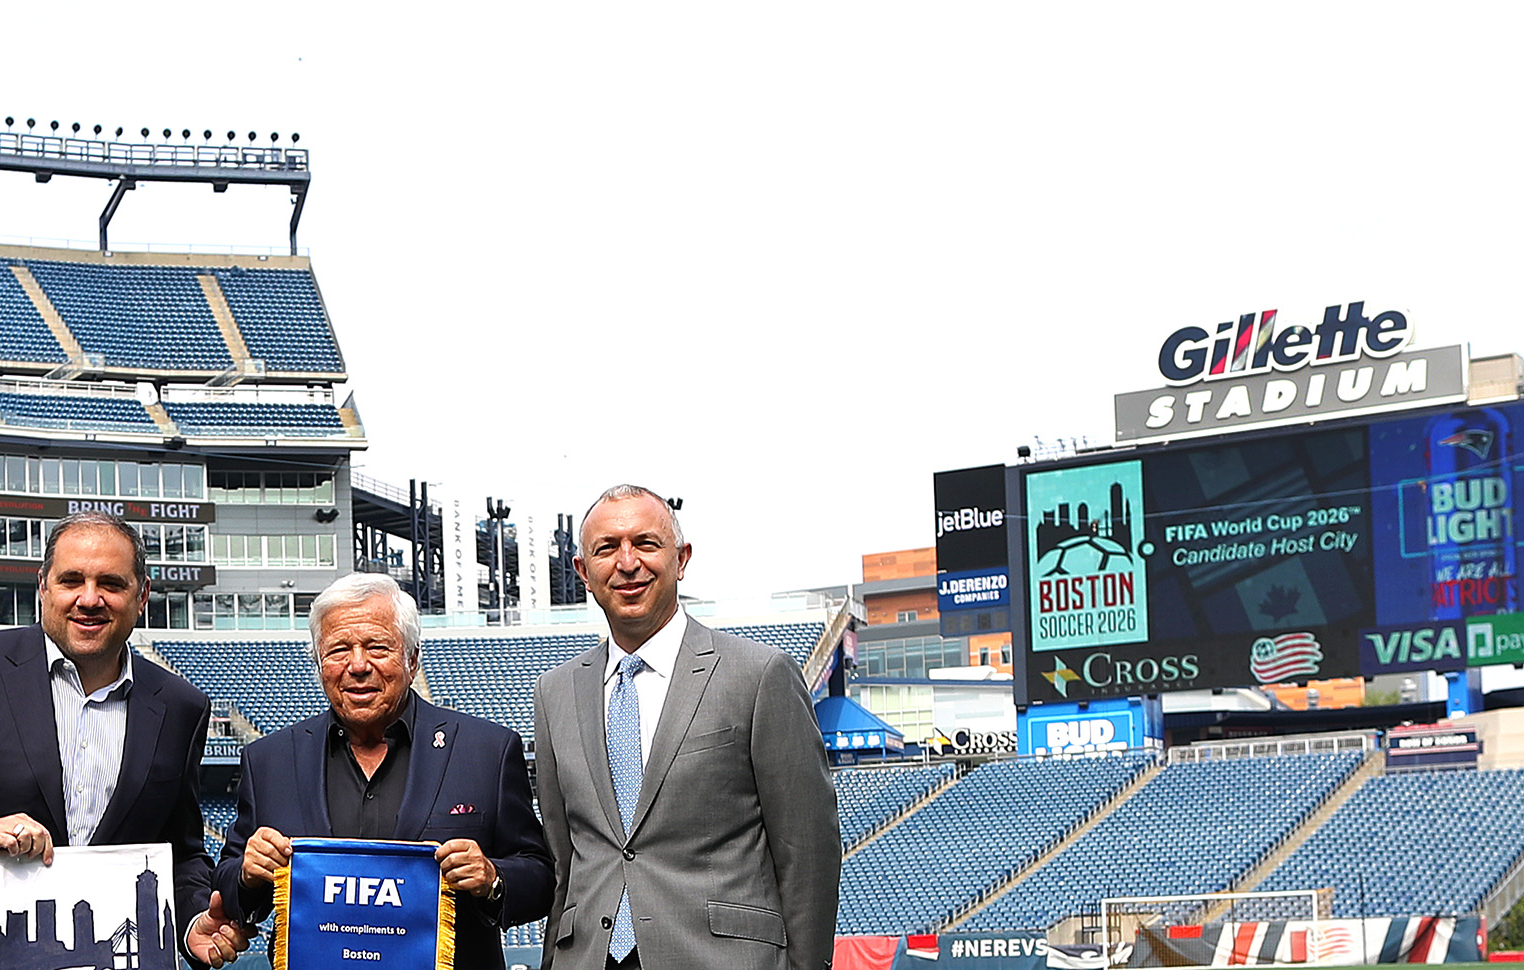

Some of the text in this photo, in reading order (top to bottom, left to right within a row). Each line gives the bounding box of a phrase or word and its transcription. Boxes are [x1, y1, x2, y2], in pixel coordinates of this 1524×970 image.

[1158, 300, 1407, 381] Gillette
[1145, 358, 1427, 430] STADIUM
[1431, 477, 1507, 514] BUD
[150, 503, 200, 519] FIGHT
[937, 507, 1003, 538] jetBlue
[1427, 507, 1514, 545] LIGHT
[1165, 524, 1208, 543] FIFA
[1210, 516, 1262, 538] World
[1266, 514, 1303, 532] Cup
[1173, 531, 1359, 566] Candidate Host City
[151, 566, 201, 581] FIGHT
[939, 575, 1007, 595] J.DERENZO
[954, 590, 1000, 604] COMPANIES
[1039, 572, 1134, 614] BOSTON
[1040, 608, 1136, 639] SOCCER 2026
[1364, 627, 1461, 664] VISA
[1046, 719, 1115, 747] BUD
[319, 923, 406, 936] with compliments to
[342, 949, 381, 961] Boston
[951, 938, 1048, 958] #NEREVS
